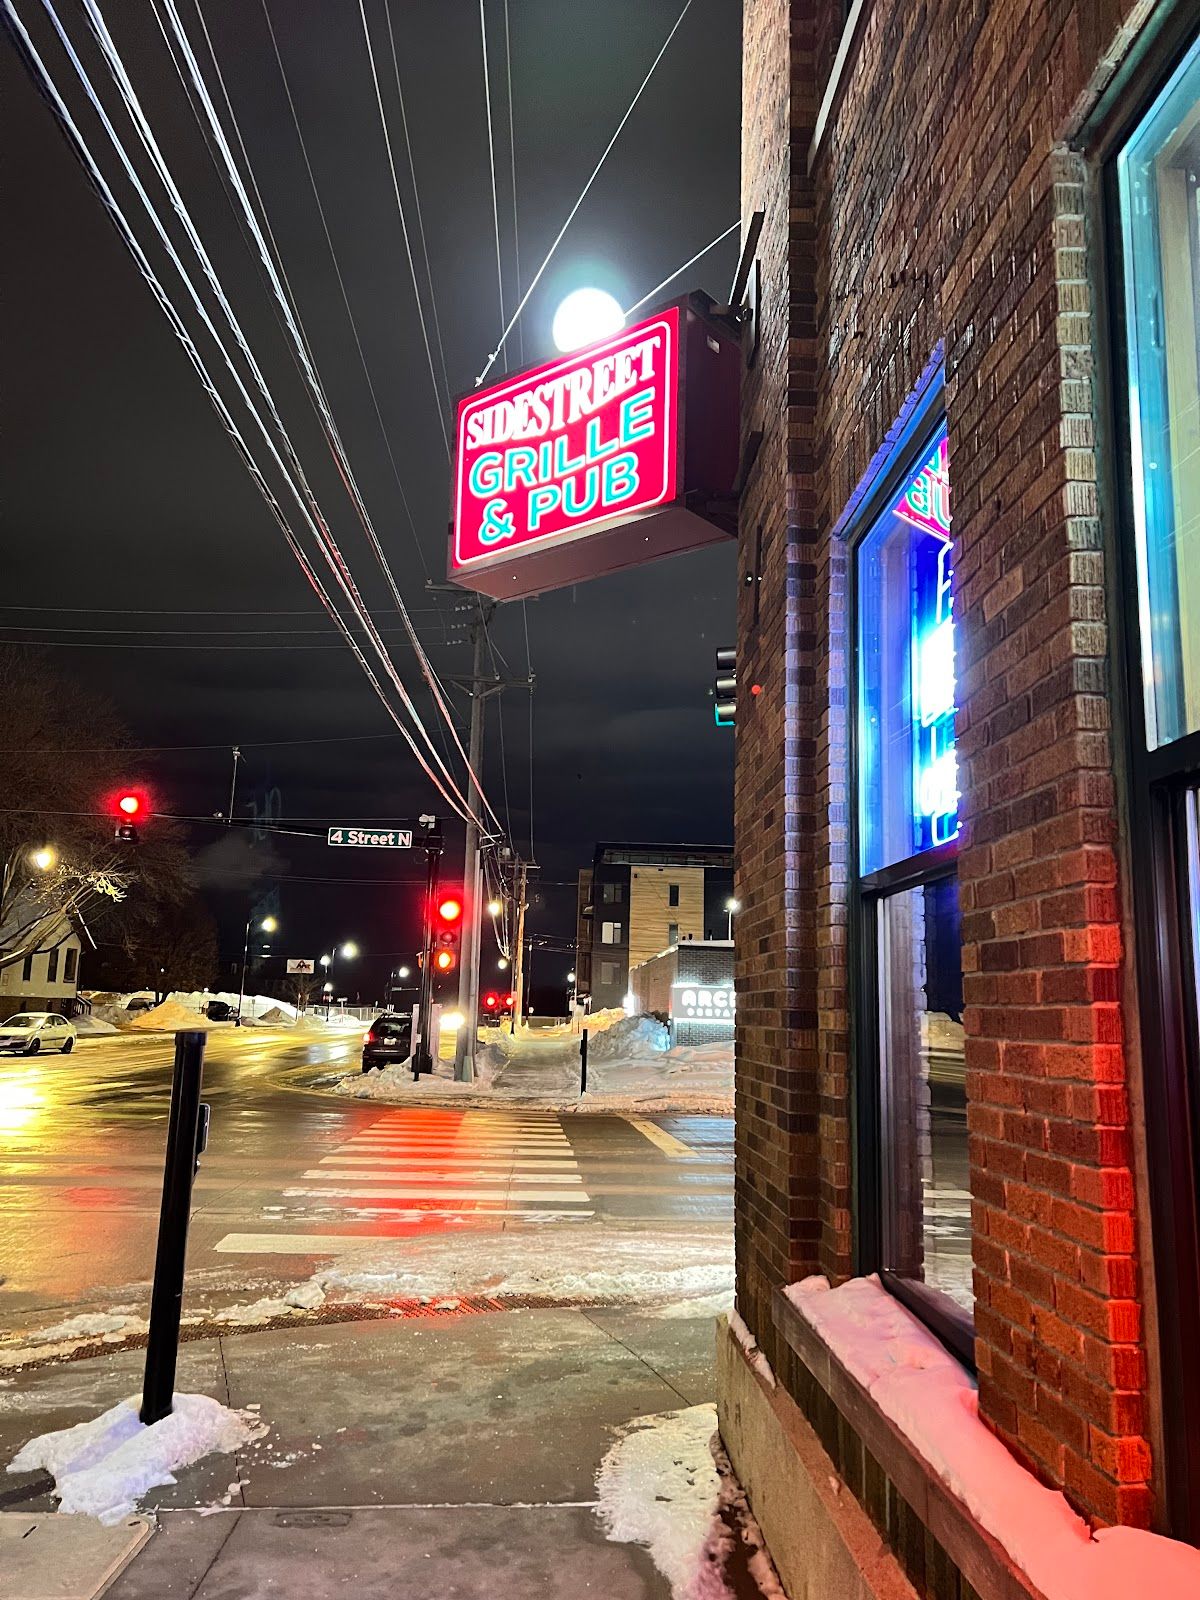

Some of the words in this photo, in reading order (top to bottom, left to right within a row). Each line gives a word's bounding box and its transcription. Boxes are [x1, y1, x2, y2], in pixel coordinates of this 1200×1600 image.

[466, 336, 660, 450] SIDESTREET
[469, 386, 656, 498] GRILLE
[478, 498, 516, 546] &
[527, 451, 640, 532] PUB
[330, 830, 343, 843] 4
[347, 830, 395, 846] Street
[398, 832, 410, 846] N
